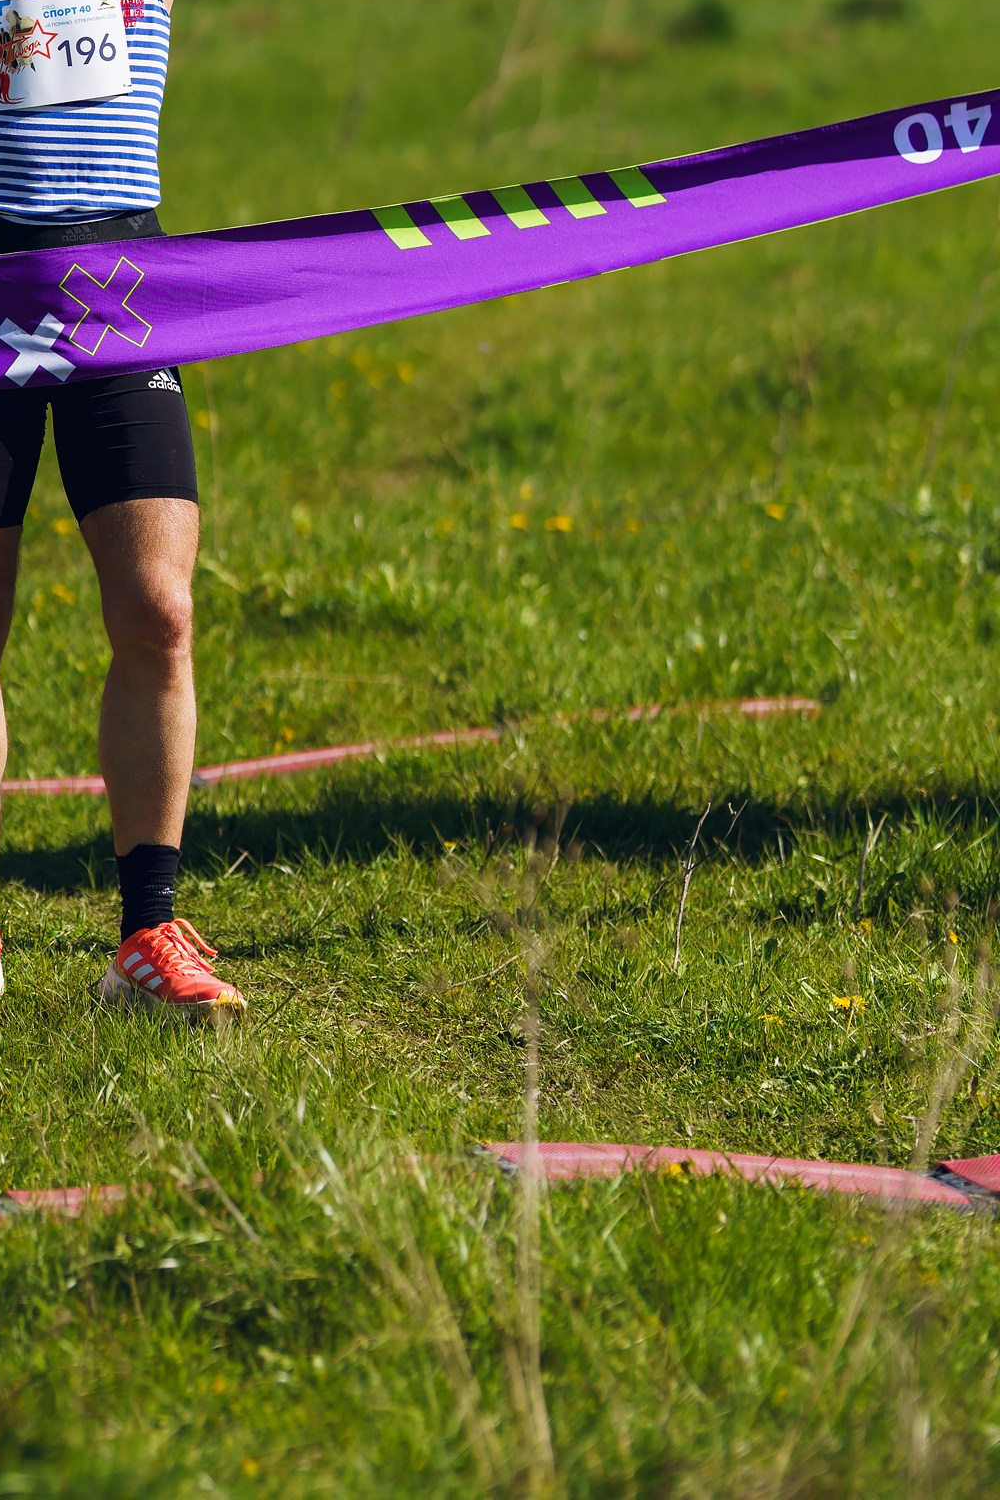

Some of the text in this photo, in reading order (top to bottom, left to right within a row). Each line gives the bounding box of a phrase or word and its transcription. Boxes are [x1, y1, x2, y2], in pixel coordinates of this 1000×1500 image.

[43, 6, 78, 19] СПОРТ
[79, 4, 92, 14] 40
[57, 33, 117, 67] 196
[893, 101, 993, 165] 40
[61, 231, 98, 242] adidas
[148, 378, 181, 393] adidas
